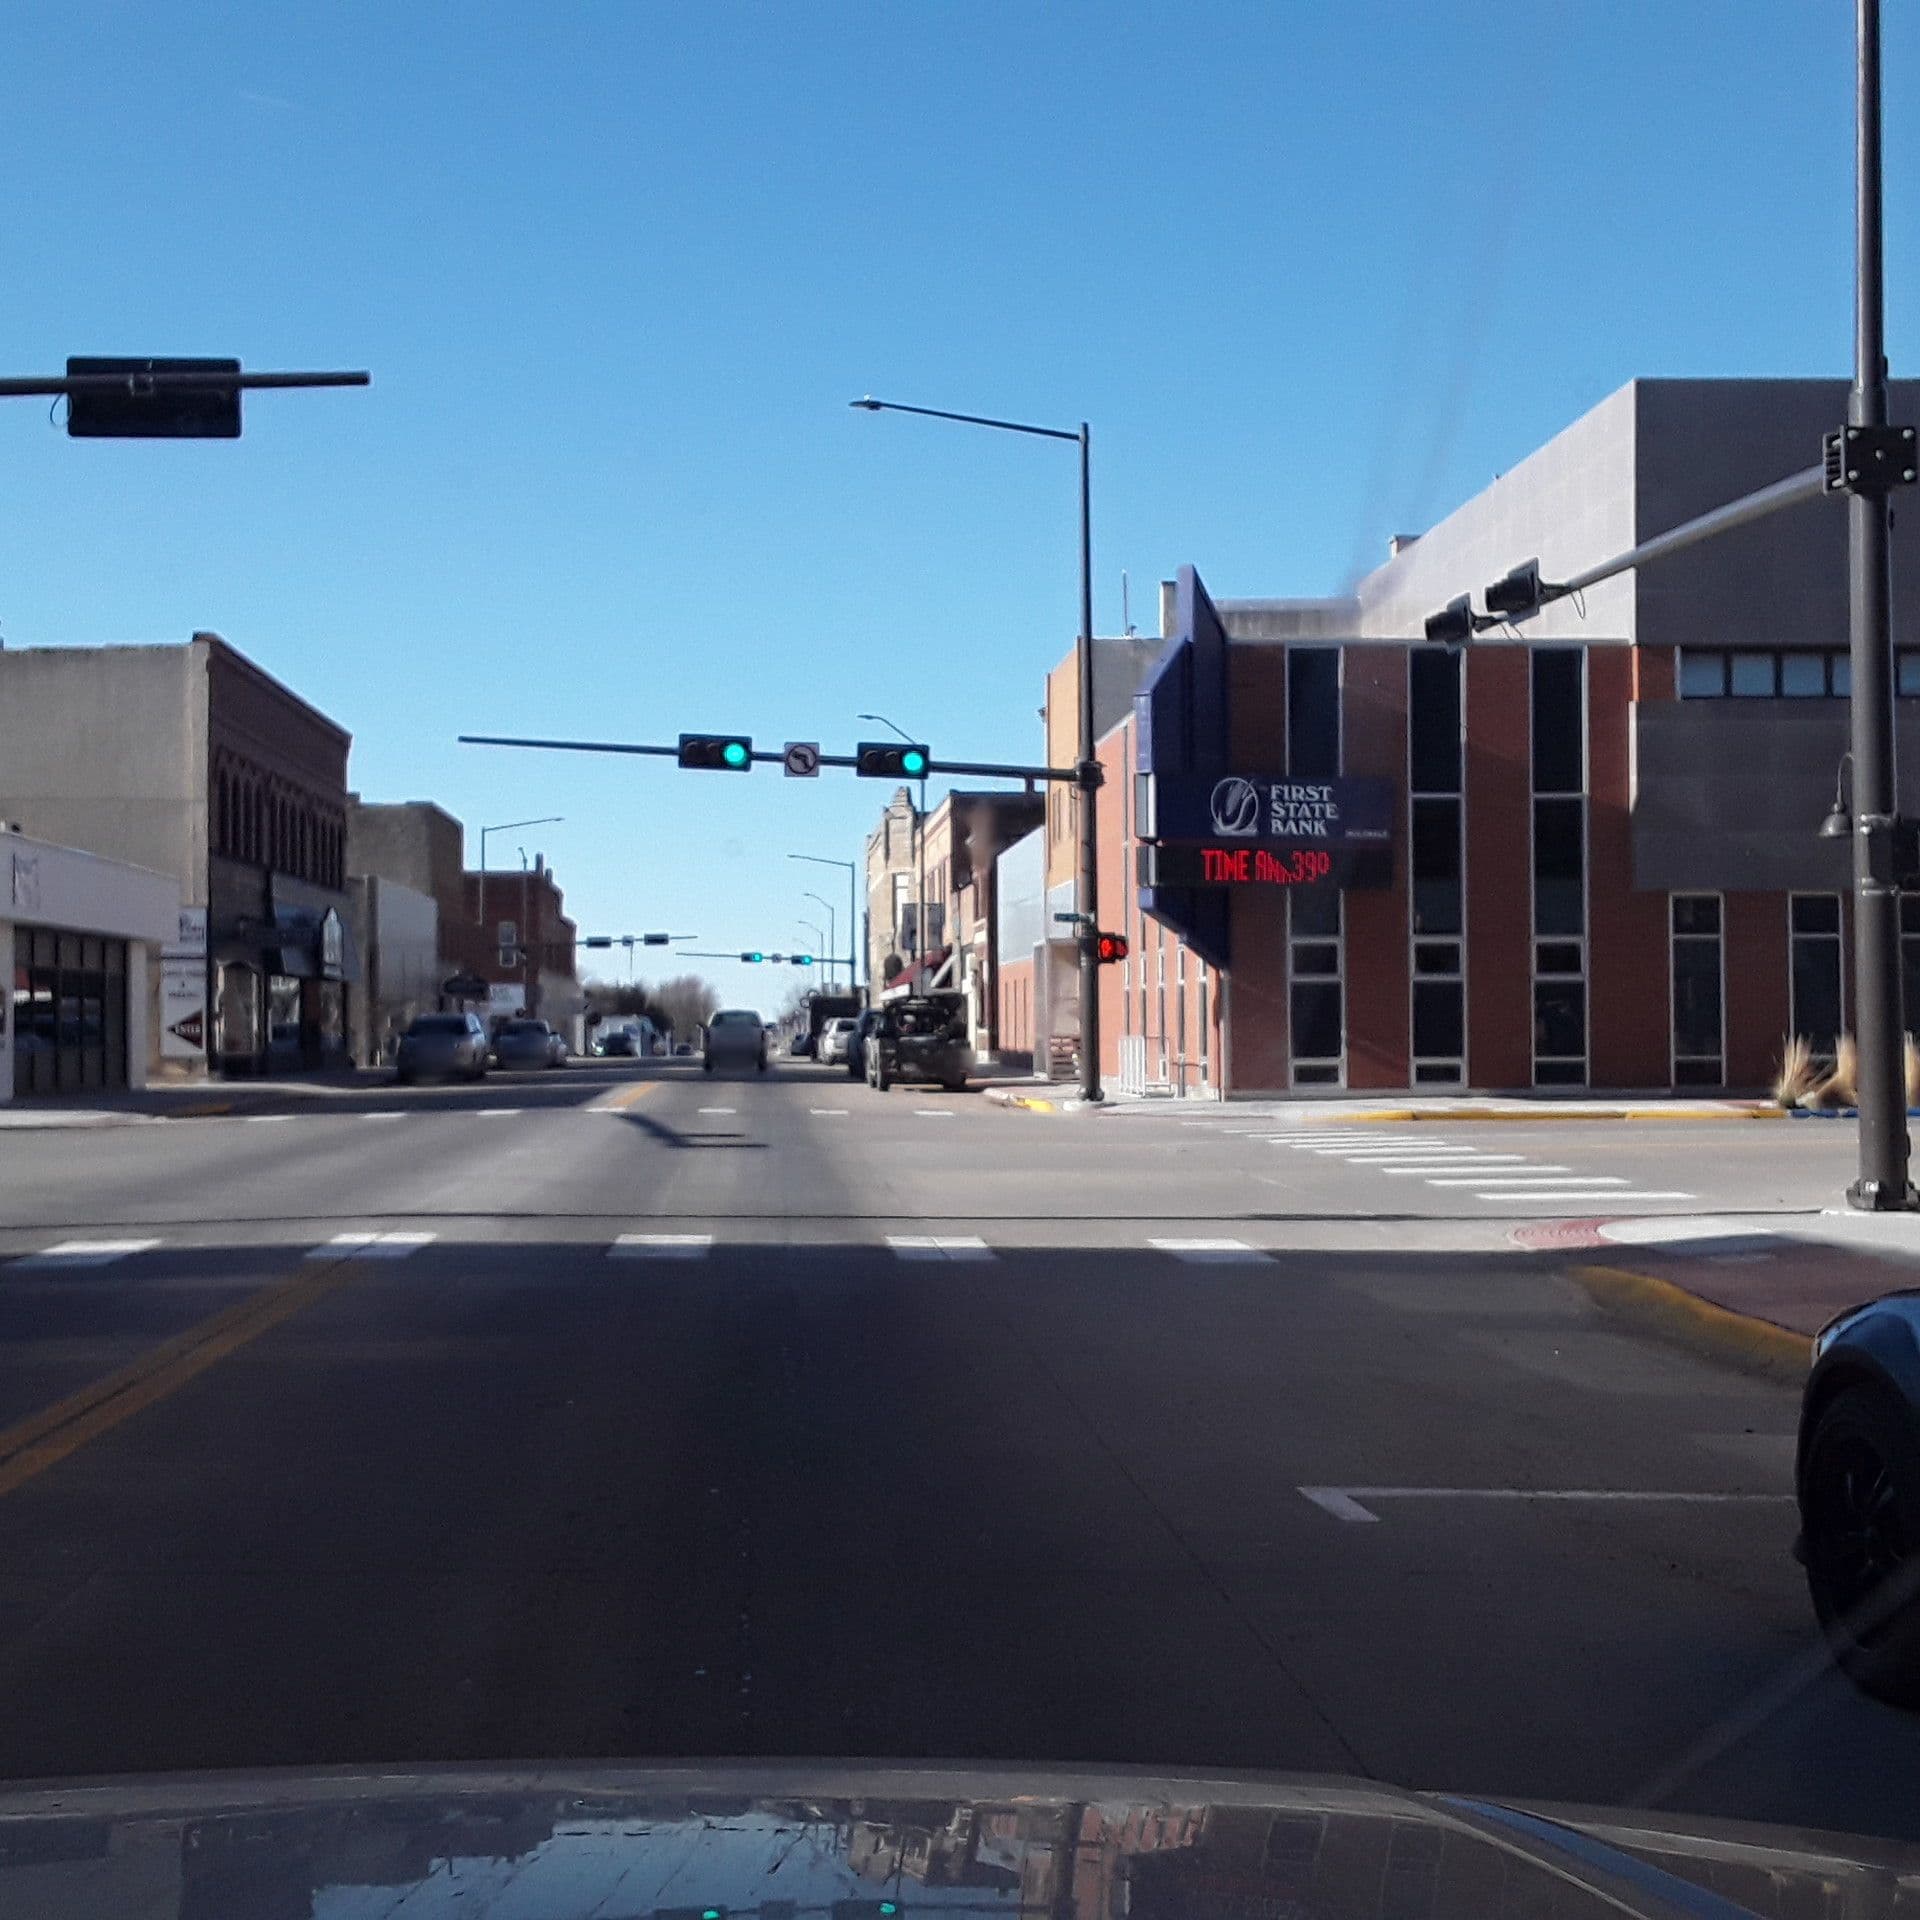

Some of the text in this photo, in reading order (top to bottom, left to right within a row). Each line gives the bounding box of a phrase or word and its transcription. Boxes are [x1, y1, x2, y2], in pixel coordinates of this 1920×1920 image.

[1270, 785, 1332, 800] FIRST
[1271, 802, 1339, 819] STATE
[1271, 820, 1327, 836] BANK
[1201, 850, 1250, 881] TIME
